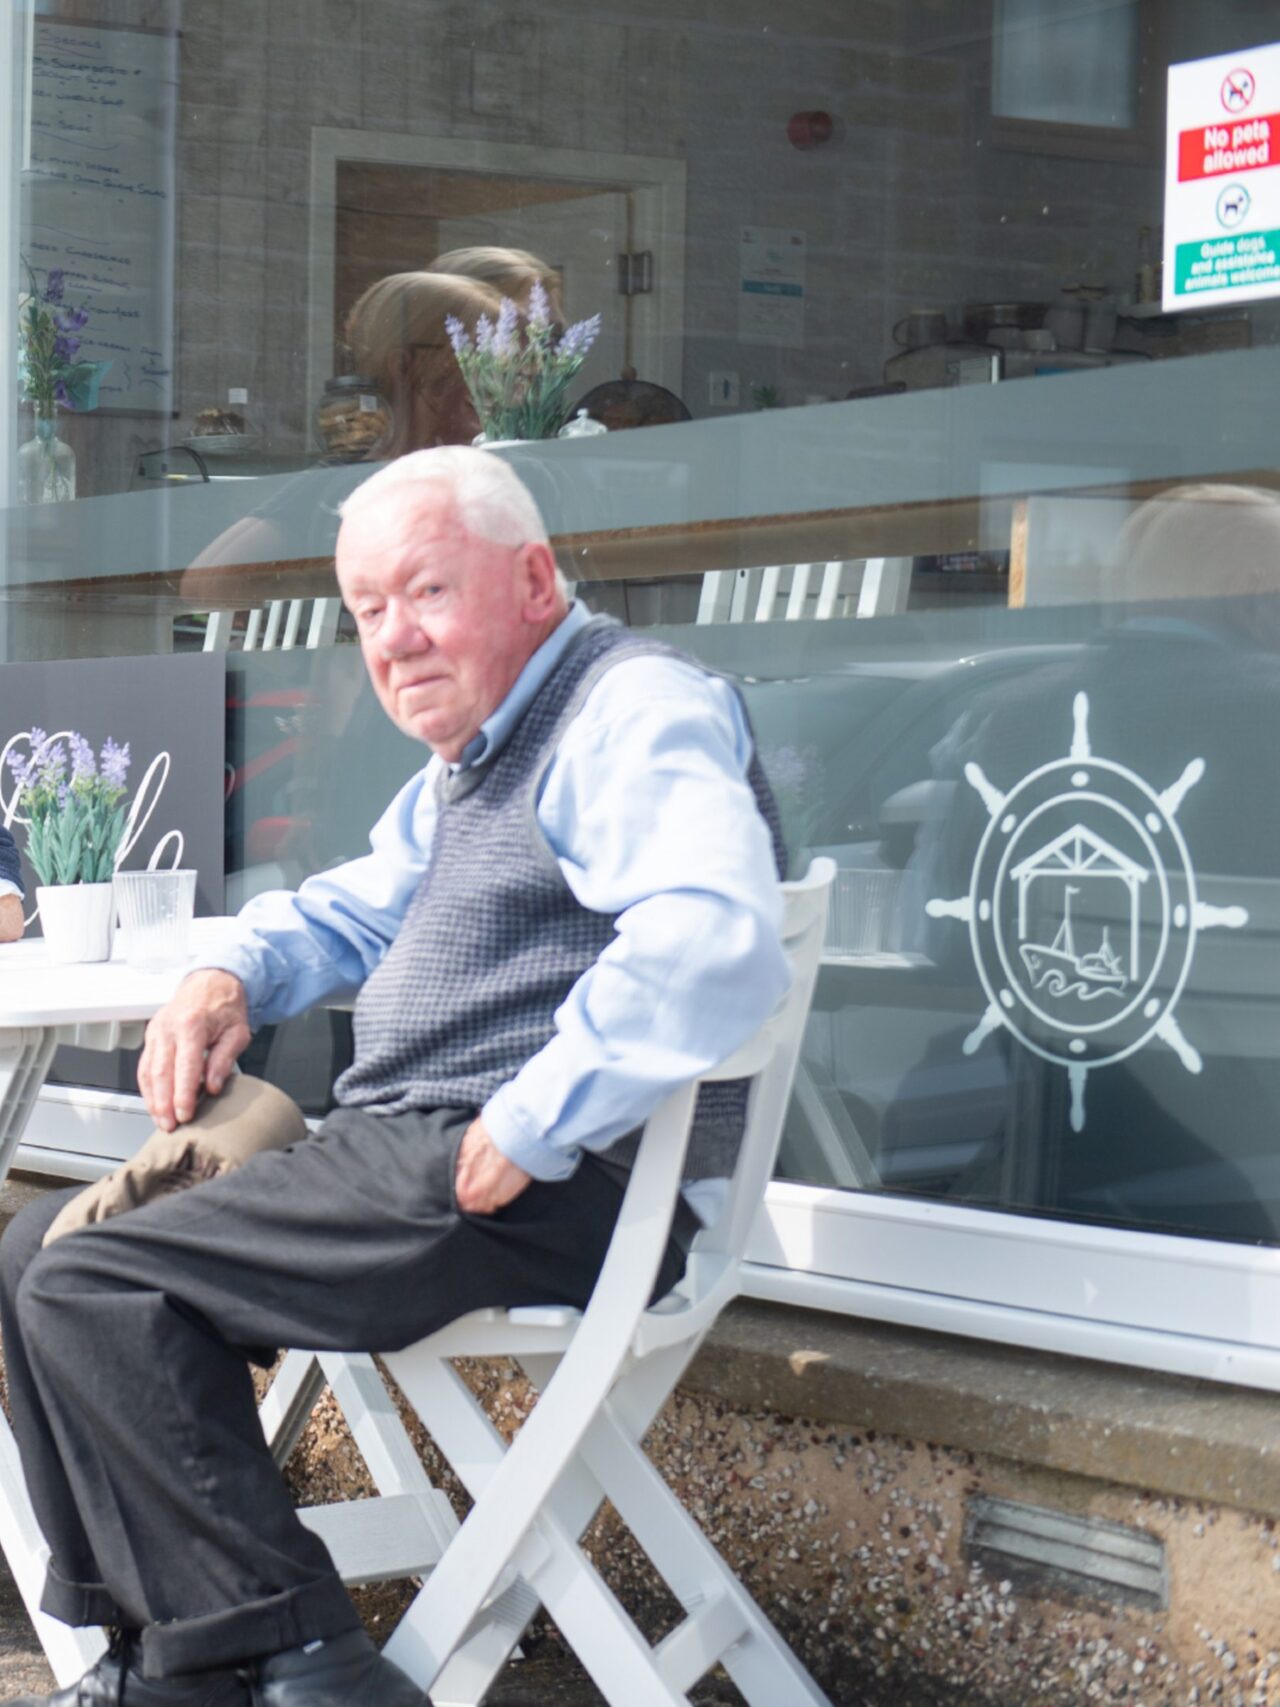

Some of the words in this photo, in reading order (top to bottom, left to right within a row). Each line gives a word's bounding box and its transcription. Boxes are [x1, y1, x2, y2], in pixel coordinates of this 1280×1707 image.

[1204, 126, 1230, 150] No
[1200, 242, 1235, 259] Guide
[1236, 236, 1266, 256] dogs
[1191, 259, 1213, 276] and
